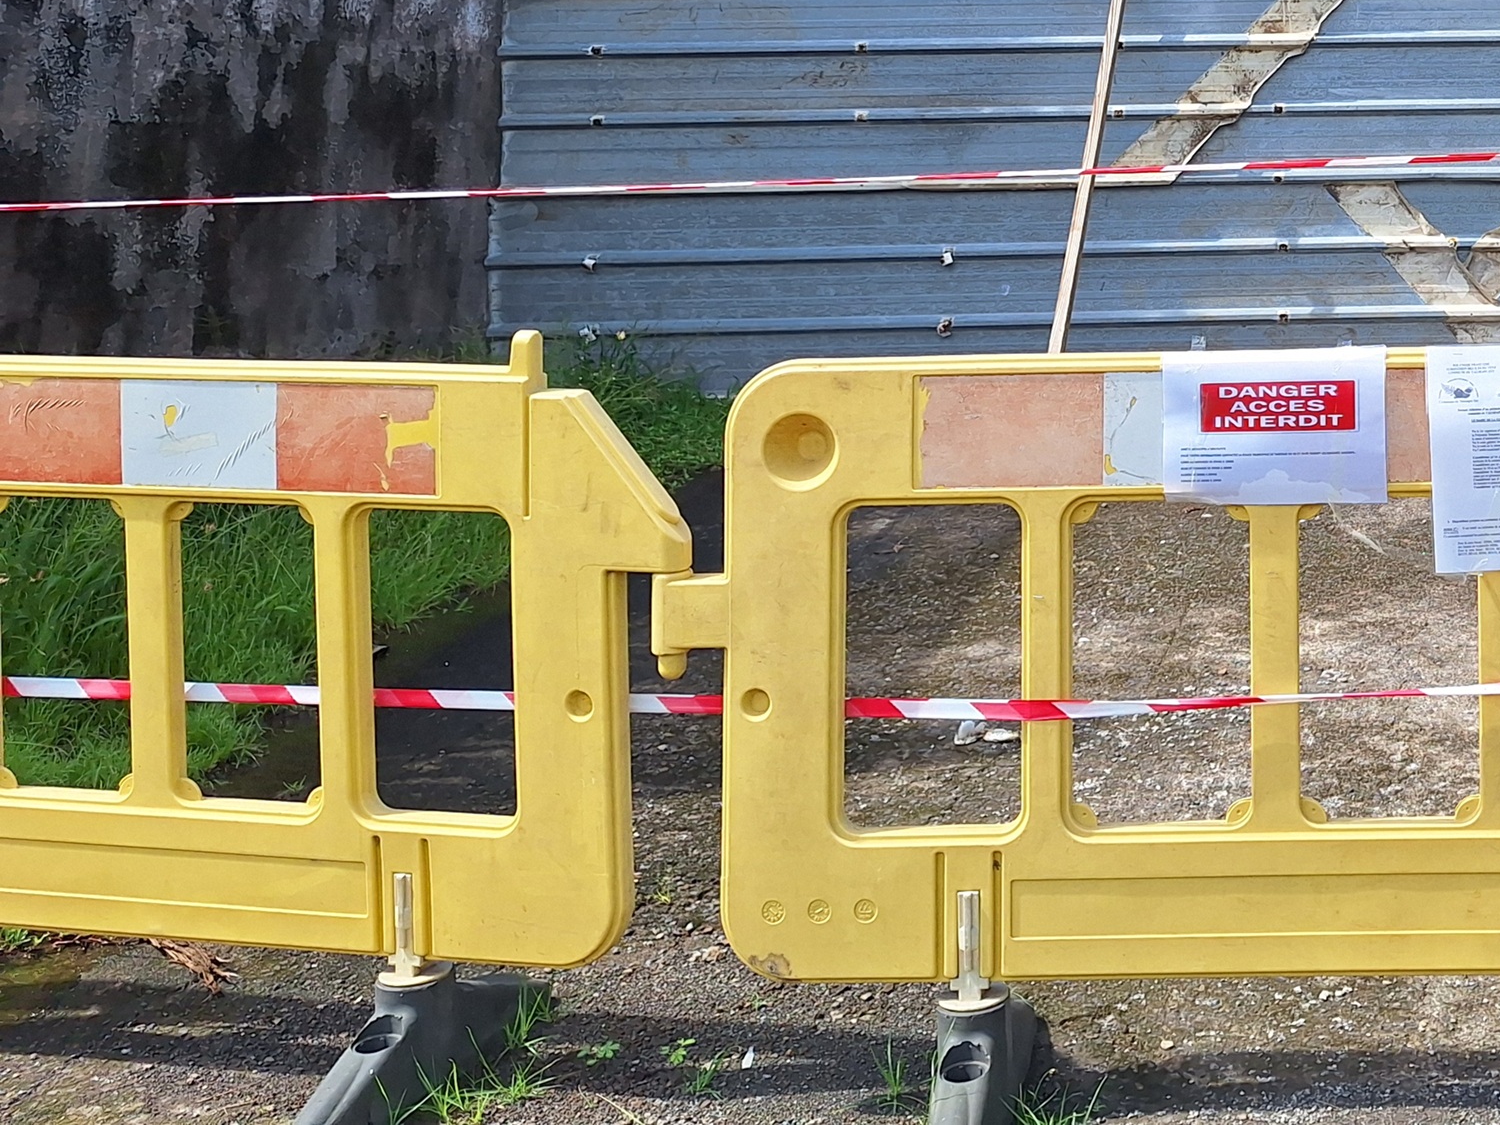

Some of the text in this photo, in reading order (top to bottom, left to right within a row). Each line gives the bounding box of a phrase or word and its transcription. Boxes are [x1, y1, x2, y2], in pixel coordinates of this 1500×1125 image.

[1219, 384, 1337, 398] DANGER
[1230, 400, 1325, 413] ACCES
[1214, 414, 1343, 428] INTERDIT
